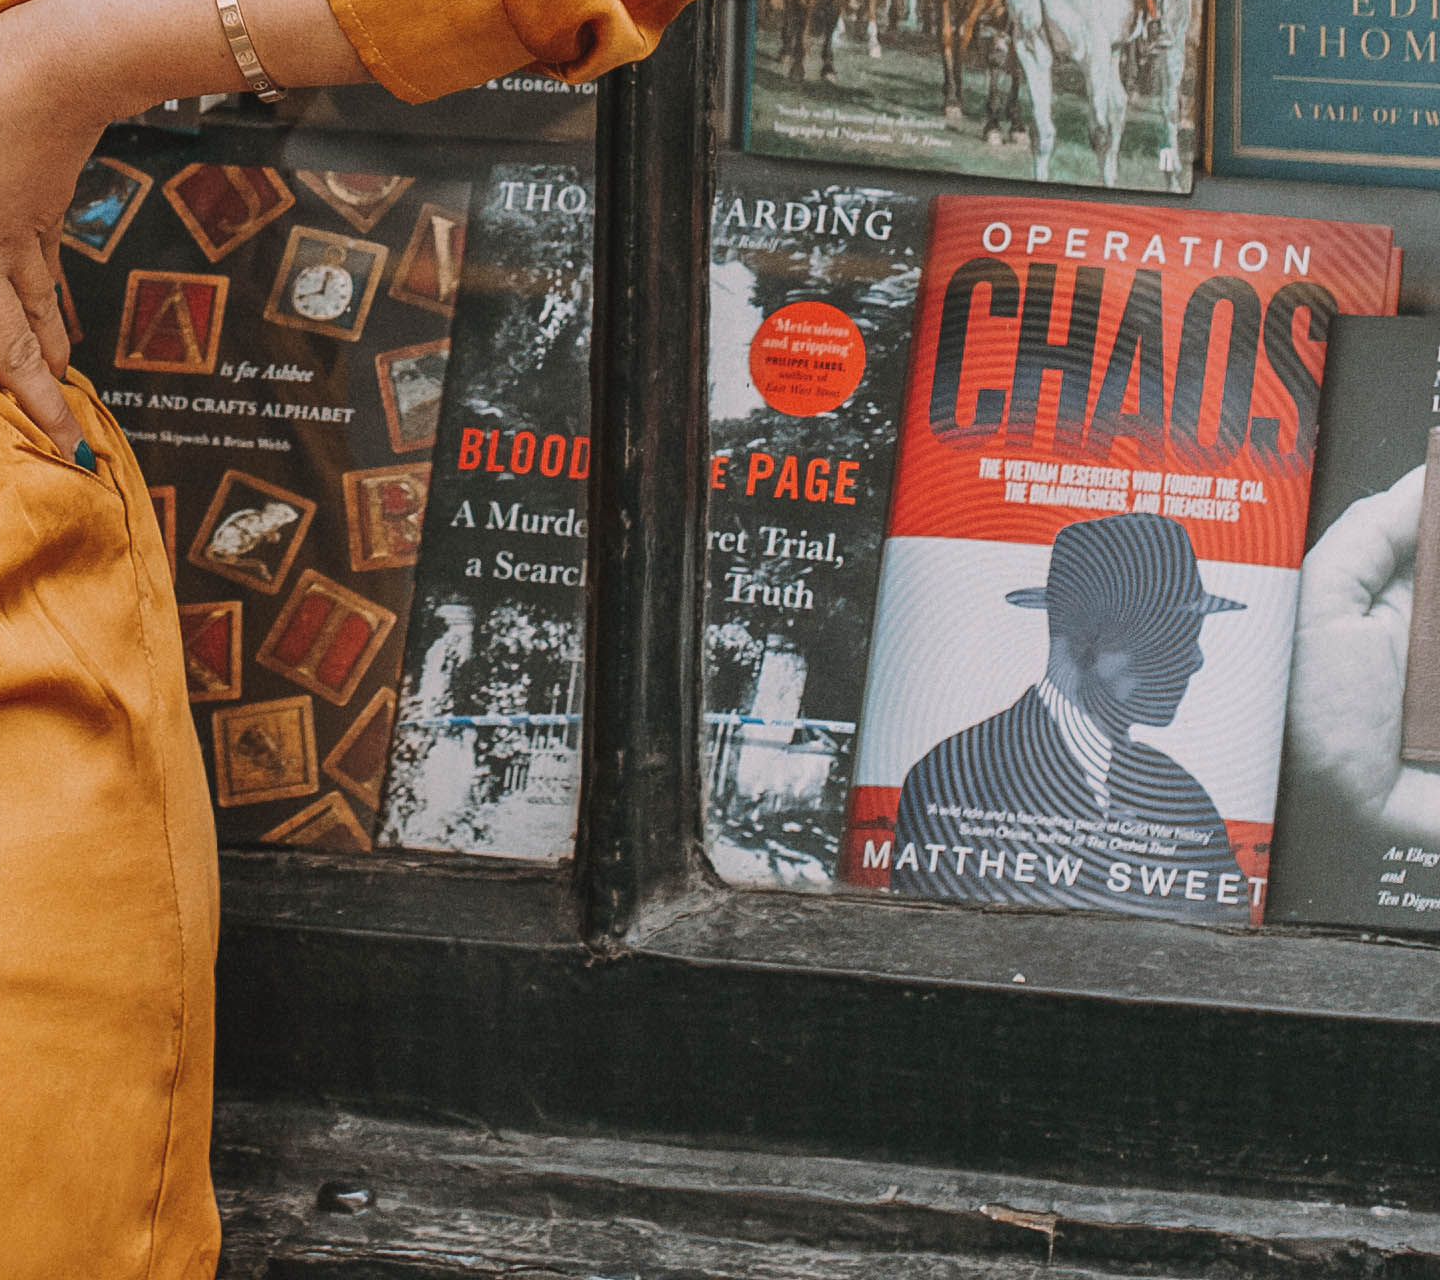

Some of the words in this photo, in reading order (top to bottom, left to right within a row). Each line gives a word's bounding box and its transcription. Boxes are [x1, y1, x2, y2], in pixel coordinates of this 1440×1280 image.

[1290, 102, 1304, 120] A
[1308, 103, 1362, 124] TALE
[1372, 107, 1403, 126] OF
[497, 181, 587, 215] THO
[981, 221, 1313, 276] OPERATION
[762, 337, 789, 349] and
[220, 361, 234, 377] is
[234, 360, 259, 383] for
[261, 361, 315, 383] Ashbee
[928, 256, 1340, 477] CHAOS
[100, 390, 144, 408] ARTS
[147, 394, 189, 412] AND
[192, 397, 257, 417] CRAFTS
[261, 402, 356, 424] ALPHABET
[745, 451, 861, 507] PAGE
[979, 457, 1003, 480] THE
[1005, 459, 1059, 484] VIETNAM
[1060, 464, 1130, 491] DESERTERS
[1132, 470, 1162, 494] WHO
[1164, 472, 1214, 499] FOUGHT
[1216, 477, 1240, 501] THE
[449, 499, 476, 529] A
[1005, 481, 1029, 504] THE
[1133, 492, 1162, 515] AND
[1163, 494, 1242, 524] THEMSELVES
[758, 525, 845, 570] Trial,
[464, 555, 483, 579] a
[723, 569, 815, 611] Truth
[1382, 845, 1404, 861] An
[862, 839, 1083, 888] MATTHEW
[1106, 861, 1269, 908] SWEET
[1379, 869, 1407, 885] and
[1378, 889, 1401, 908] Ten
